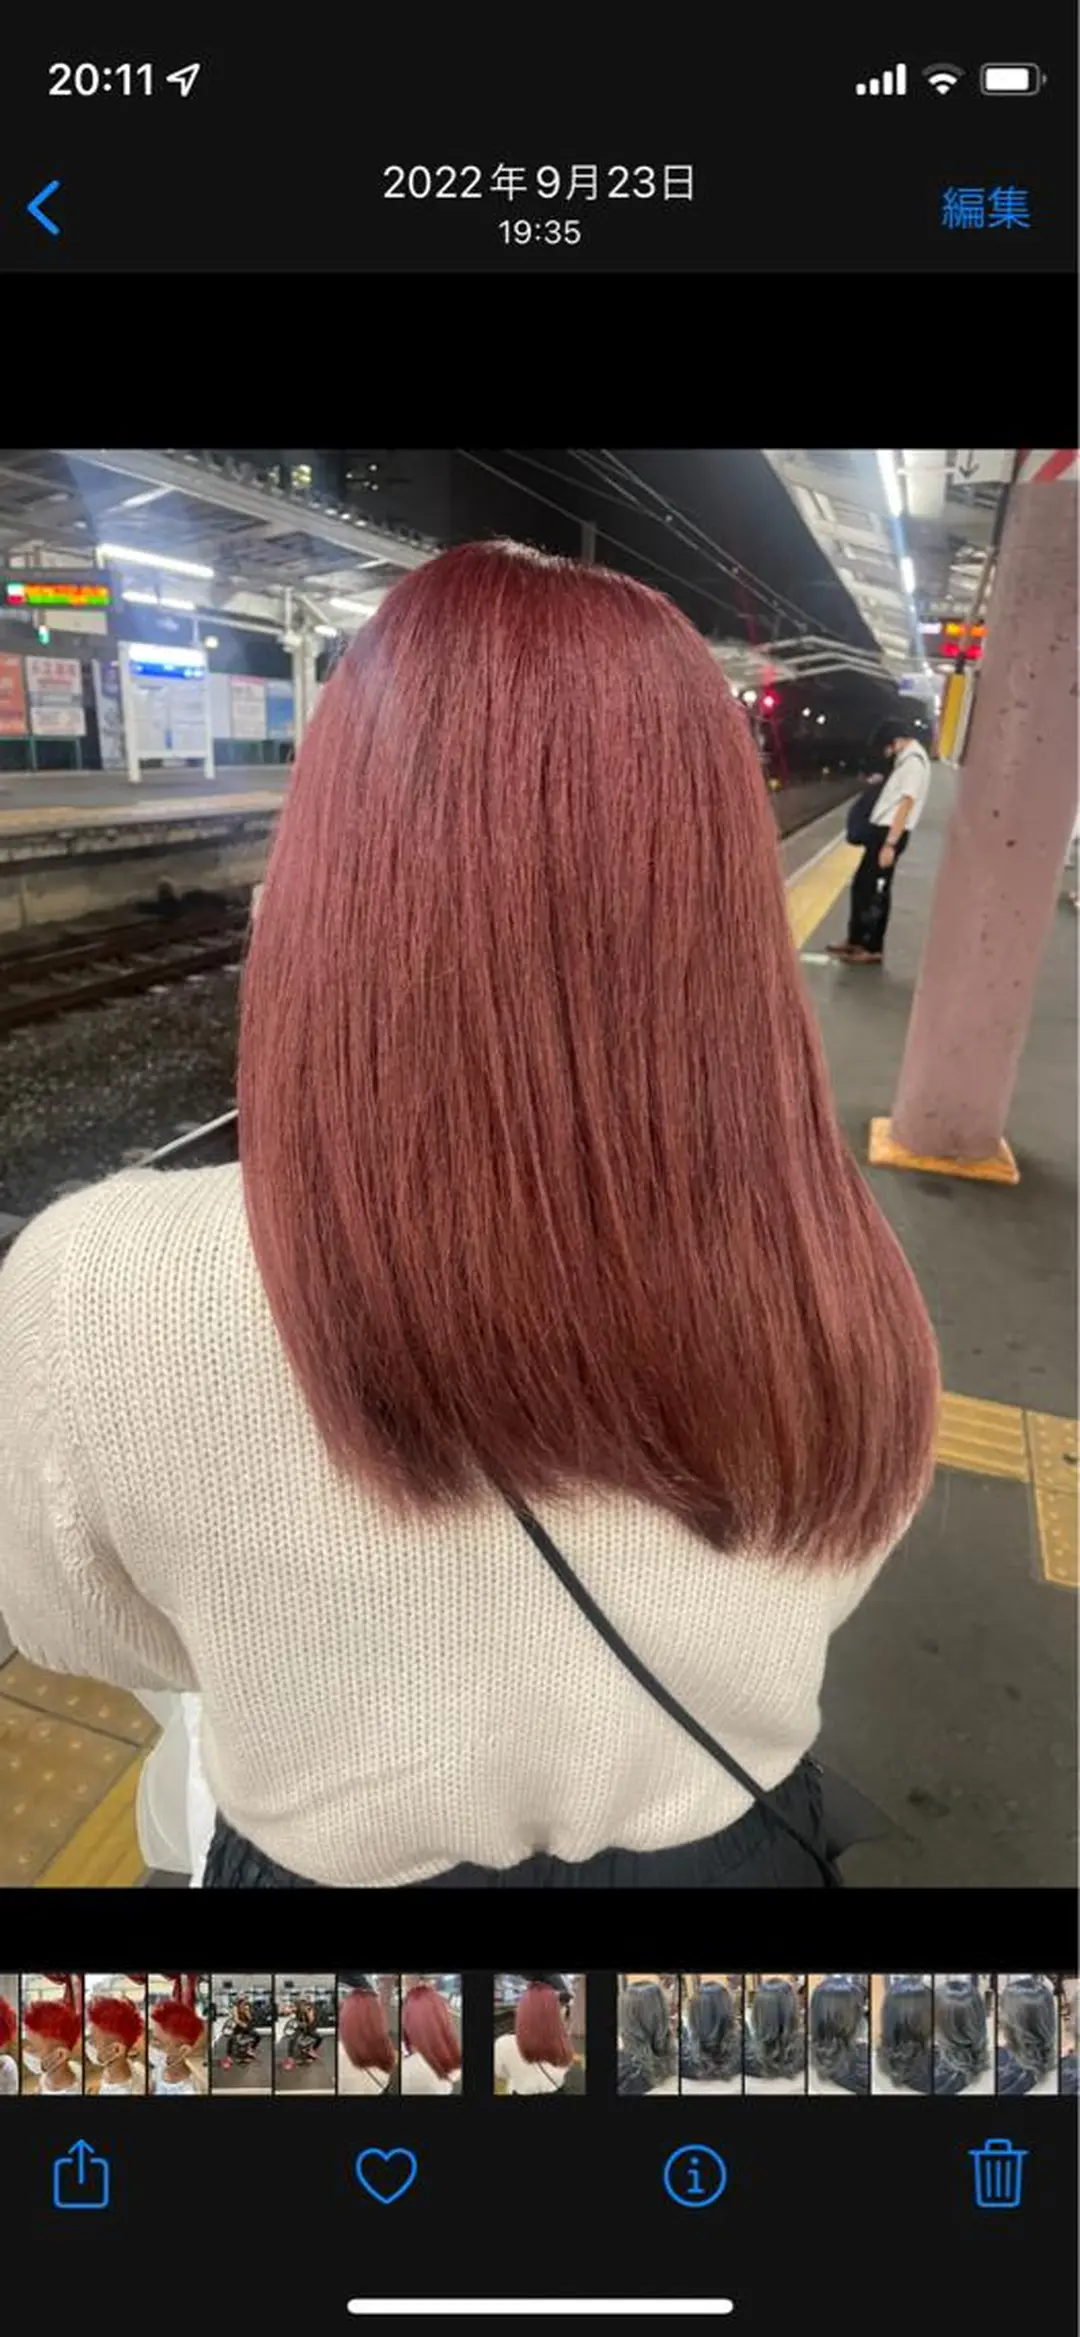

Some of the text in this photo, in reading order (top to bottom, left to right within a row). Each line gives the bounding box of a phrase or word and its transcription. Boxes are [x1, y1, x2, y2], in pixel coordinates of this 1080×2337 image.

[48, 63, 153, 97] 20:11
[383, 162, 694, 202] 2022年9月23日
[942, 186, 1030, 230] 編集
[498, 219, 582, 245] 19:35
